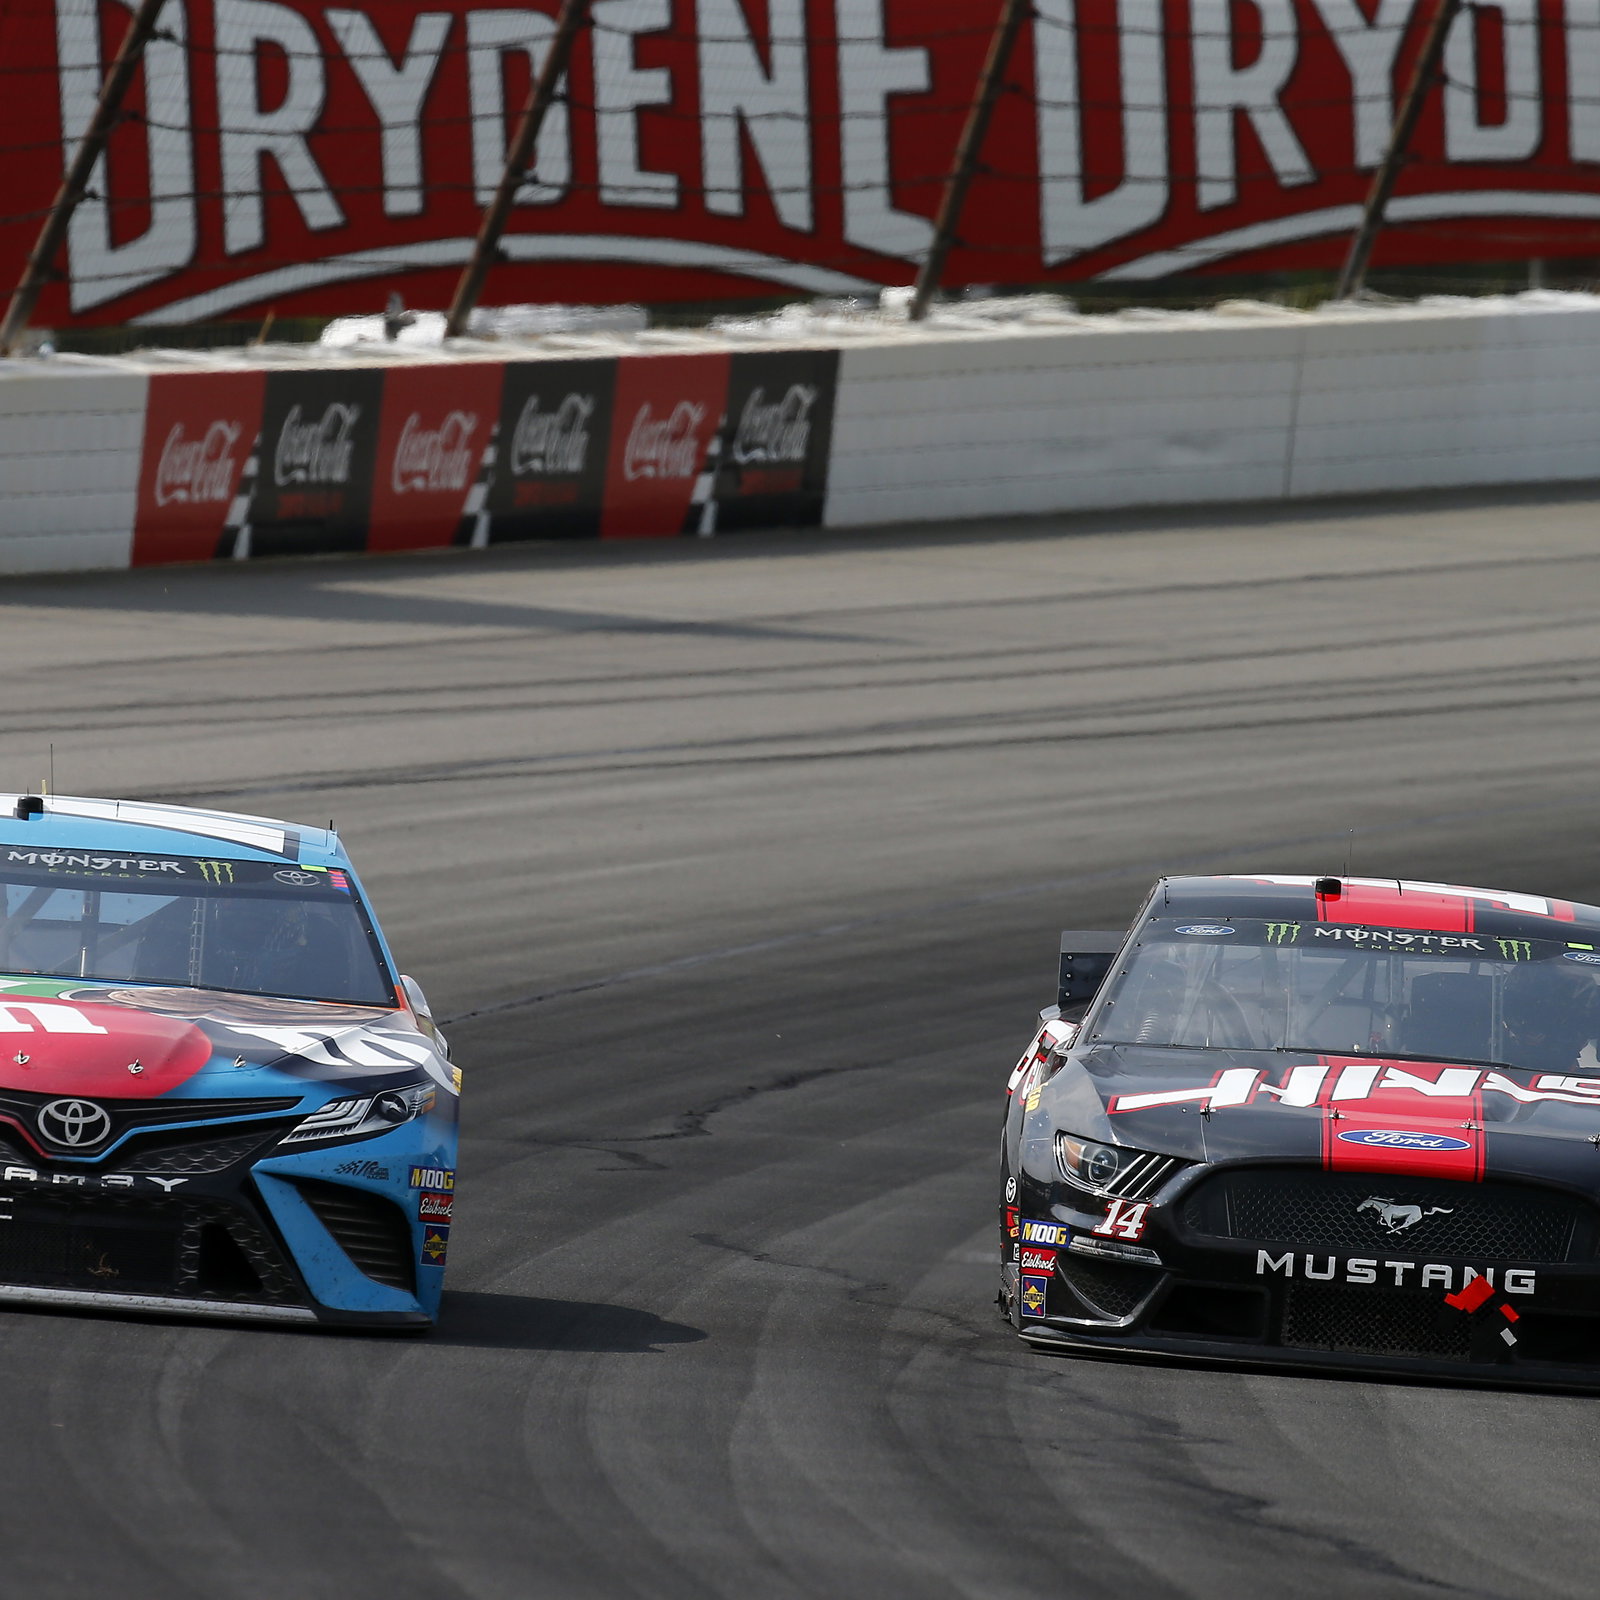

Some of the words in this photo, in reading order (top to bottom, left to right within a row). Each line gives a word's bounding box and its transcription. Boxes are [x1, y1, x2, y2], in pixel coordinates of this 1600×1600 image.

[54, 0, 936, 314] DRYDENE
[8, 850, 187, 875] MONSTER
[48, 868, 147, 879] ENERGY
[1184, 926, 1226, 935] Ford
[1314, 927, 1486, 951] MONSTER
[1355, 943, 1448, 955] ENERGY
[1363, 1130, 1444, 1149] Ford
[4, 1166, 189, 1192] AMRY
[411, 1168, 455, 1190] MOOG
[420, 1197, 453, 1217] Edelbrock
[1093, 1199, 1150, 1240] 14
[1022, 1222, 1068, 1245] MOOG
[1021, 1251, 1057, 1272] Edelbrock
[1256, 1249, 1536, 1294] MUSTANG
